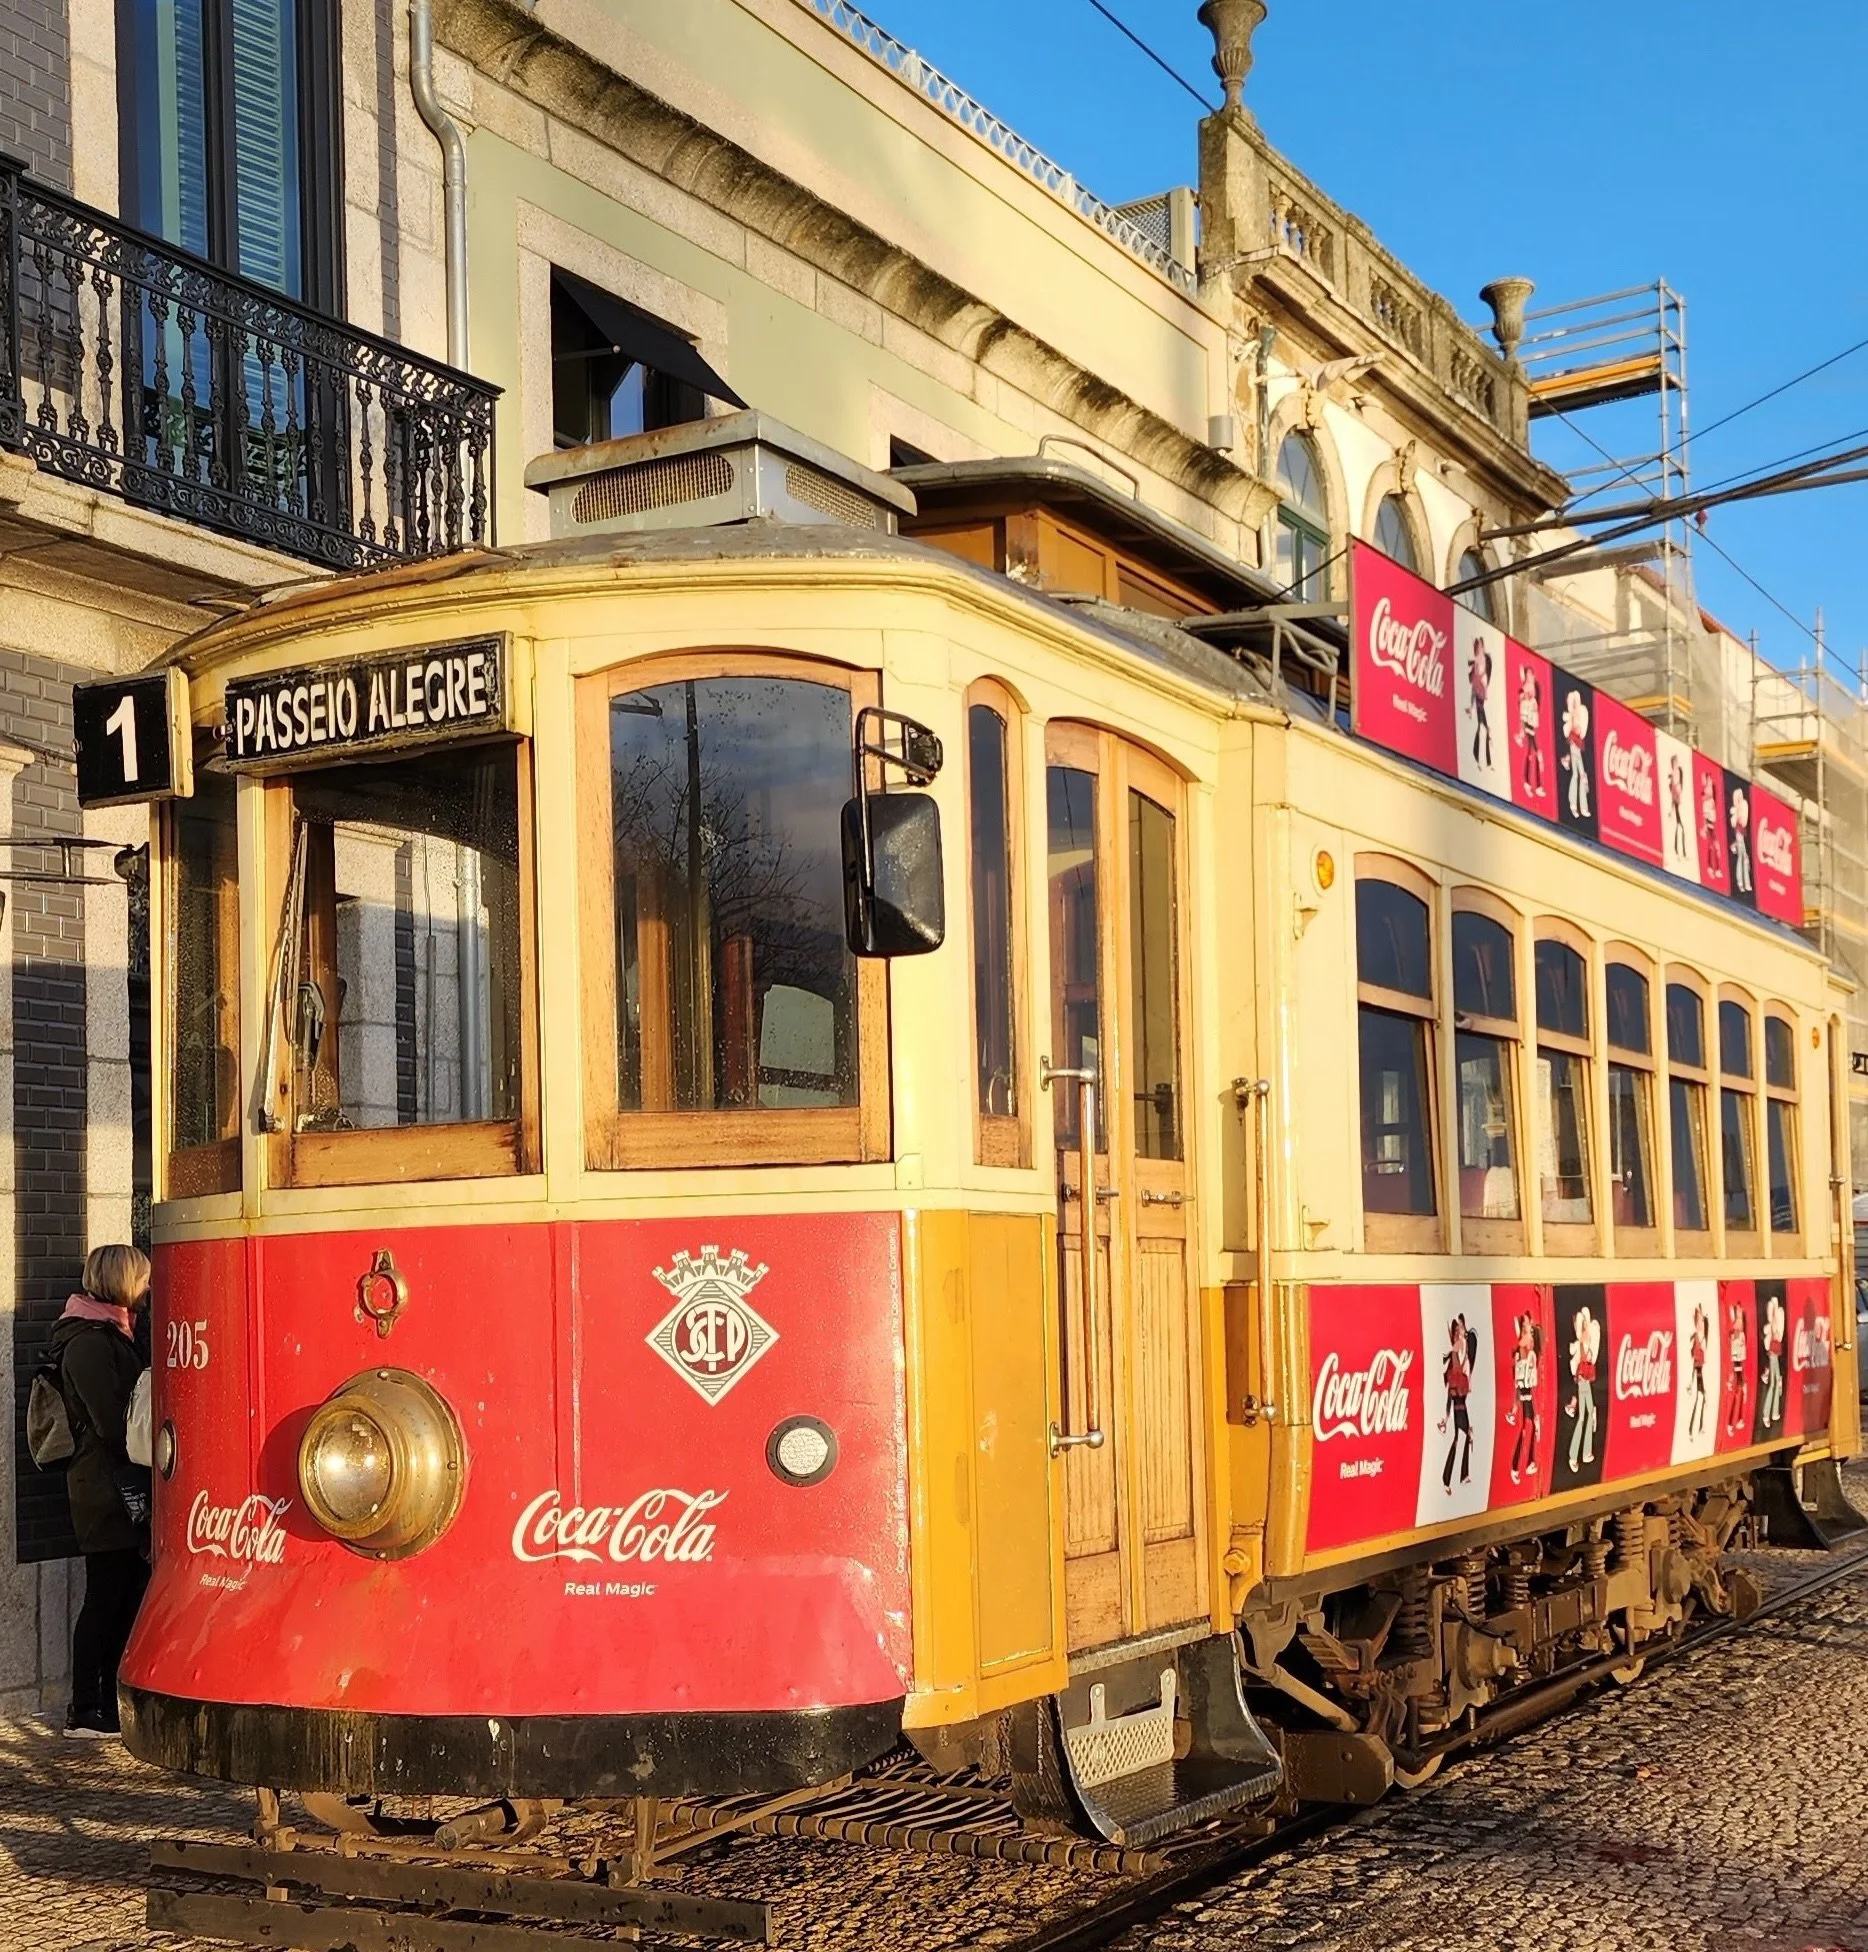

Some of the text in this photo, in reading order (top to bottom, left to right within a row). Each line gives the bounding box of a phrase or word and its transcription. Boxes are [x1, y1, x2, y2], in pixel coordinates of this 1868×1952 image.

[1370, 597, 1447, 698] Coca-Cola
[106, 695, 138, 783] 1
[236, 653, 487, 755] PASSEIO ALEGRE
[166, 1319, 209, 1370] 205
[1615, 1330, 1673, 1400] Coca-Cola
[1313, 1349, 1414, 1442] Coca-Cola
[1340, 1460, 1358, 1479] Real
[187, 1490, 293, 1564] Coca-Cola
[512, 1488, 731, 1563] Coca-Cola
[199, 1573, 247, 1592] Real Magic
[564, 1582, 656, 1598] Real Magic
